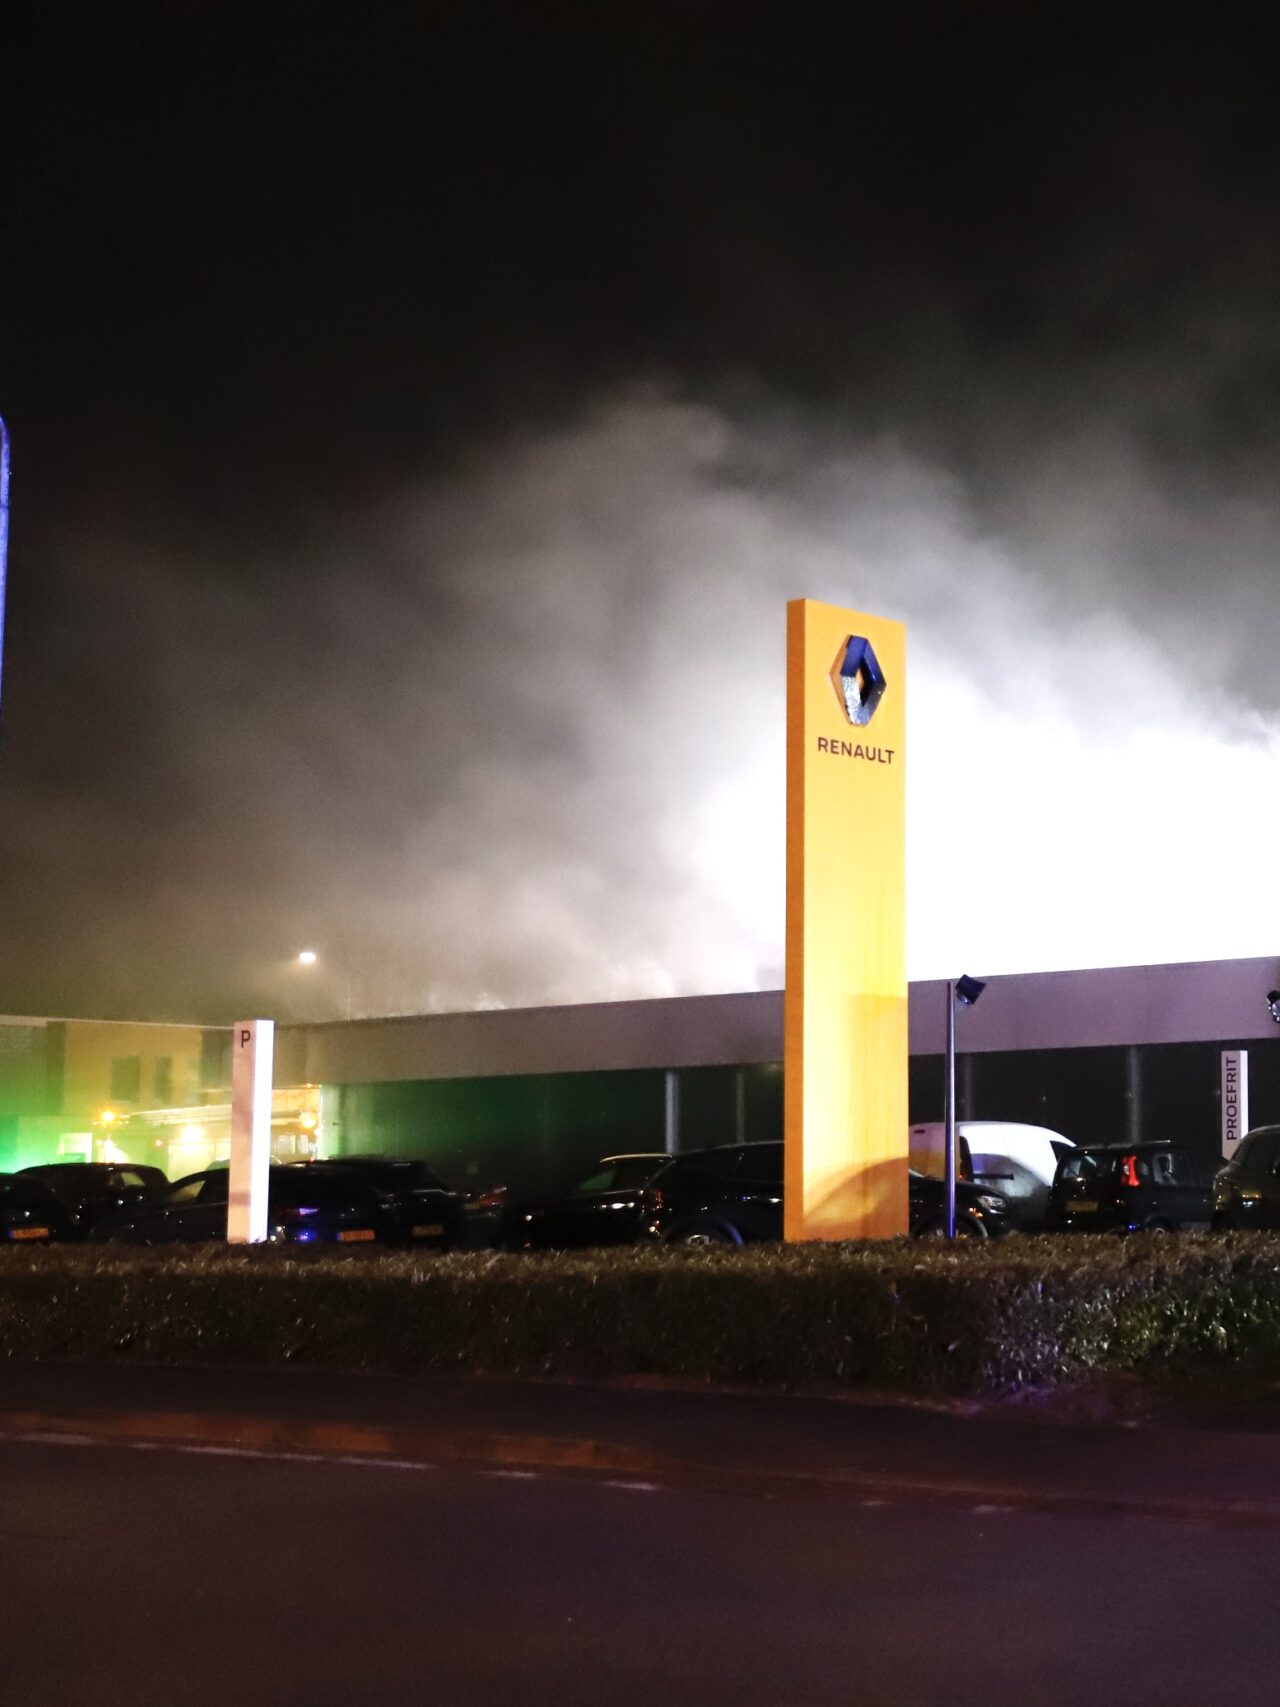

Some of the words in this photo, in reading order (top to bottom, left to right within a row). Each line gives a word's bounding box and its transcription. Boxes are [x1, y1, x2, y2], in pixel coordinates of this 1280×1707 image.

[817, 736, 895, 765] RENAULT
[241, 1030, 251, 1049] P
[1226, 1057, 1237, 1141] PROEFRIT
